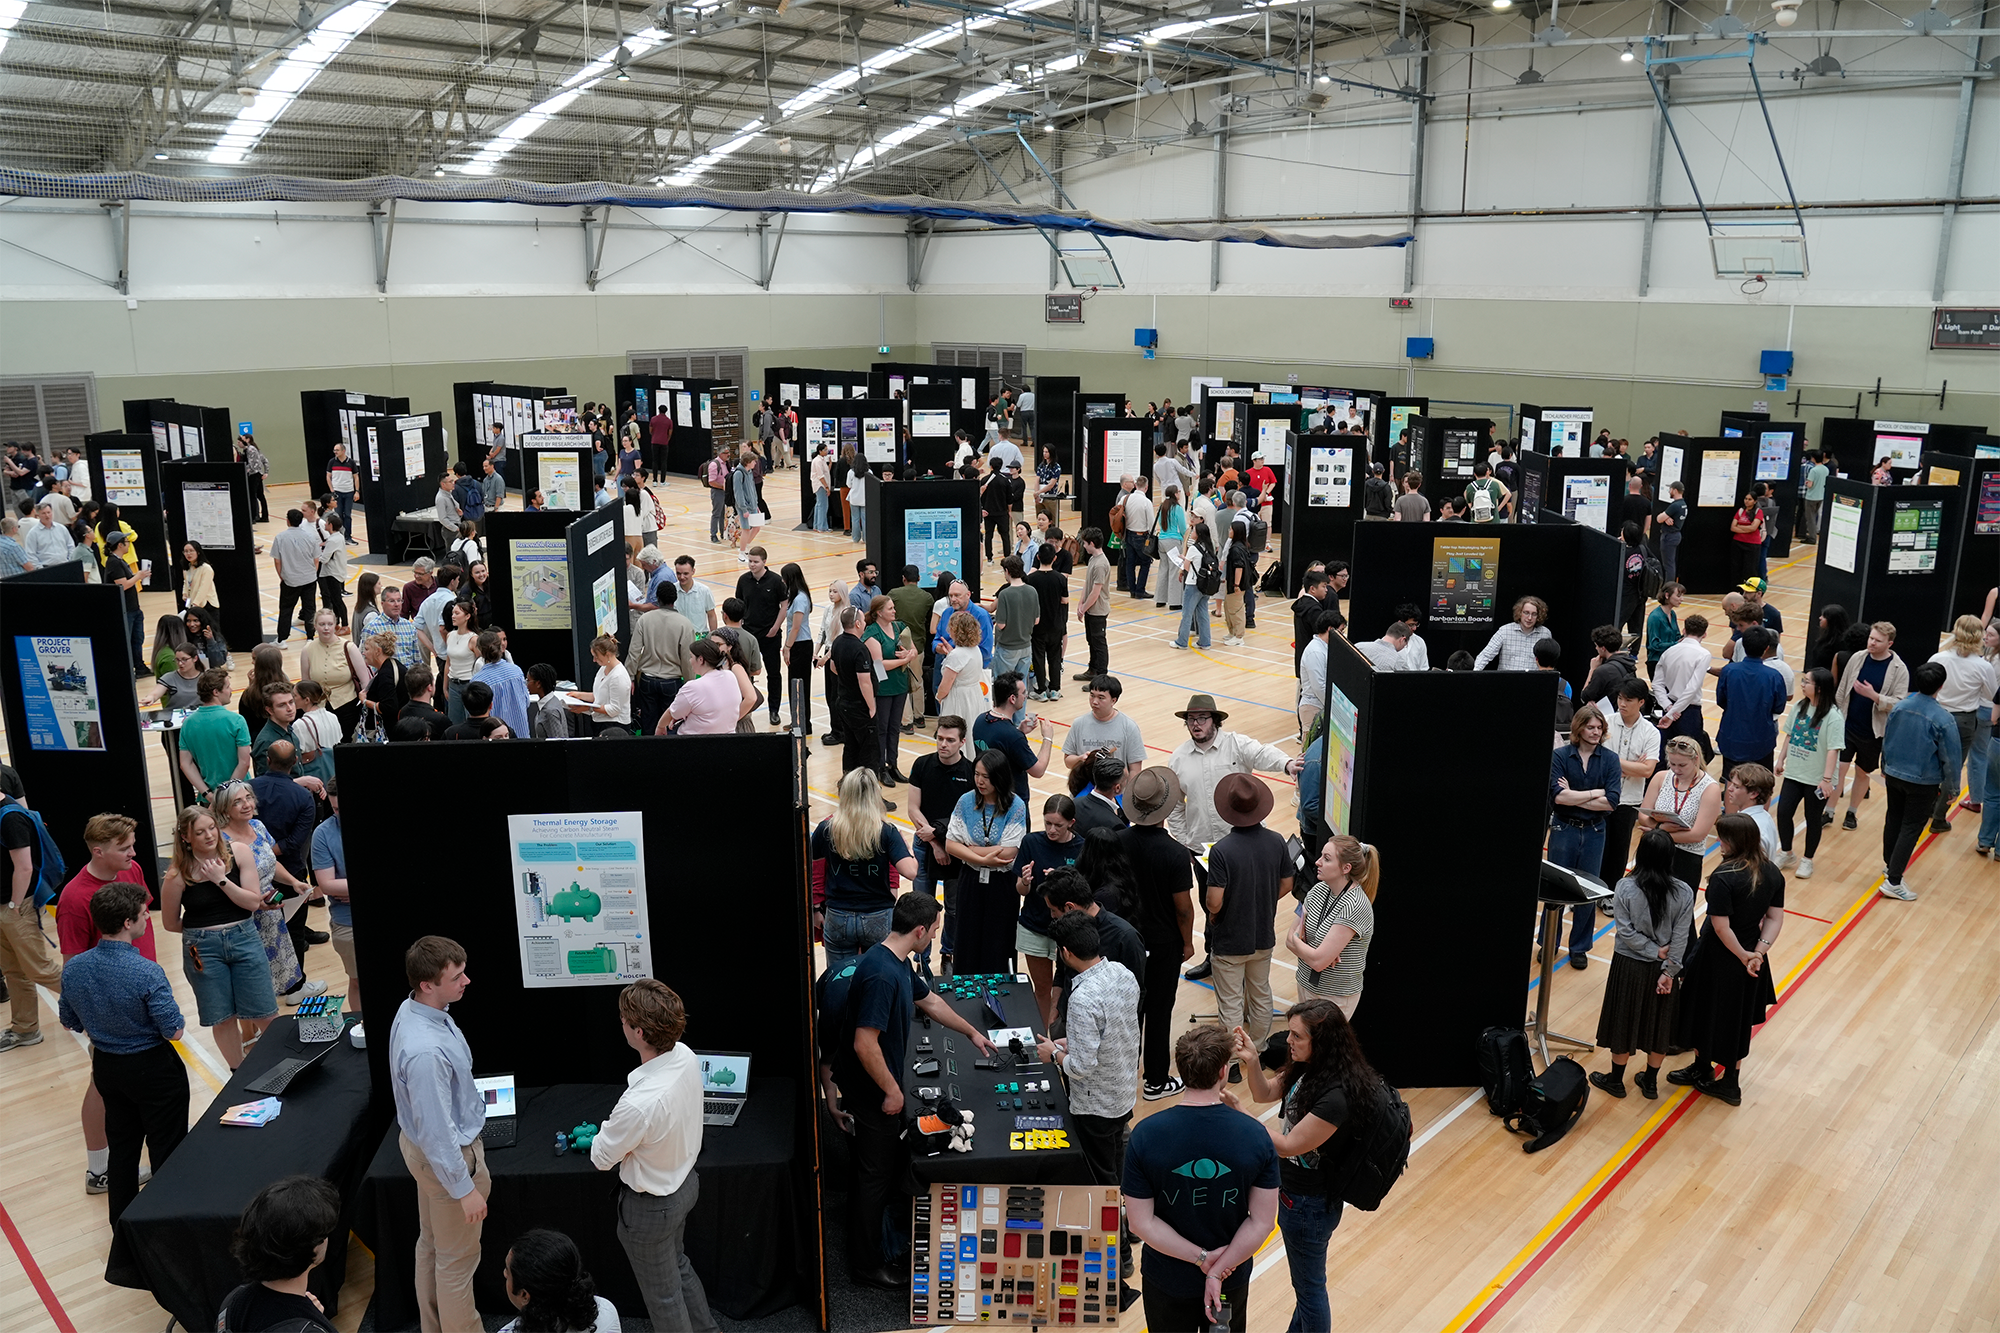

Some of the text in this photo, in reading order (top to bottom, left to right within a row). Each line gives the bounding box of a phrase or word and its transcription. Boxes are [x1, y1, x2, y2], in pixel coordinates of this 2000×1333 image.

[37, 638, 71, 646] PROJECT
[38, 646, 72, 654] GROVER
[564, 818, 588, 827] Energy
[590, 818, 618, 826] Storage
[1162, 1186, 1239, 1208] VER
